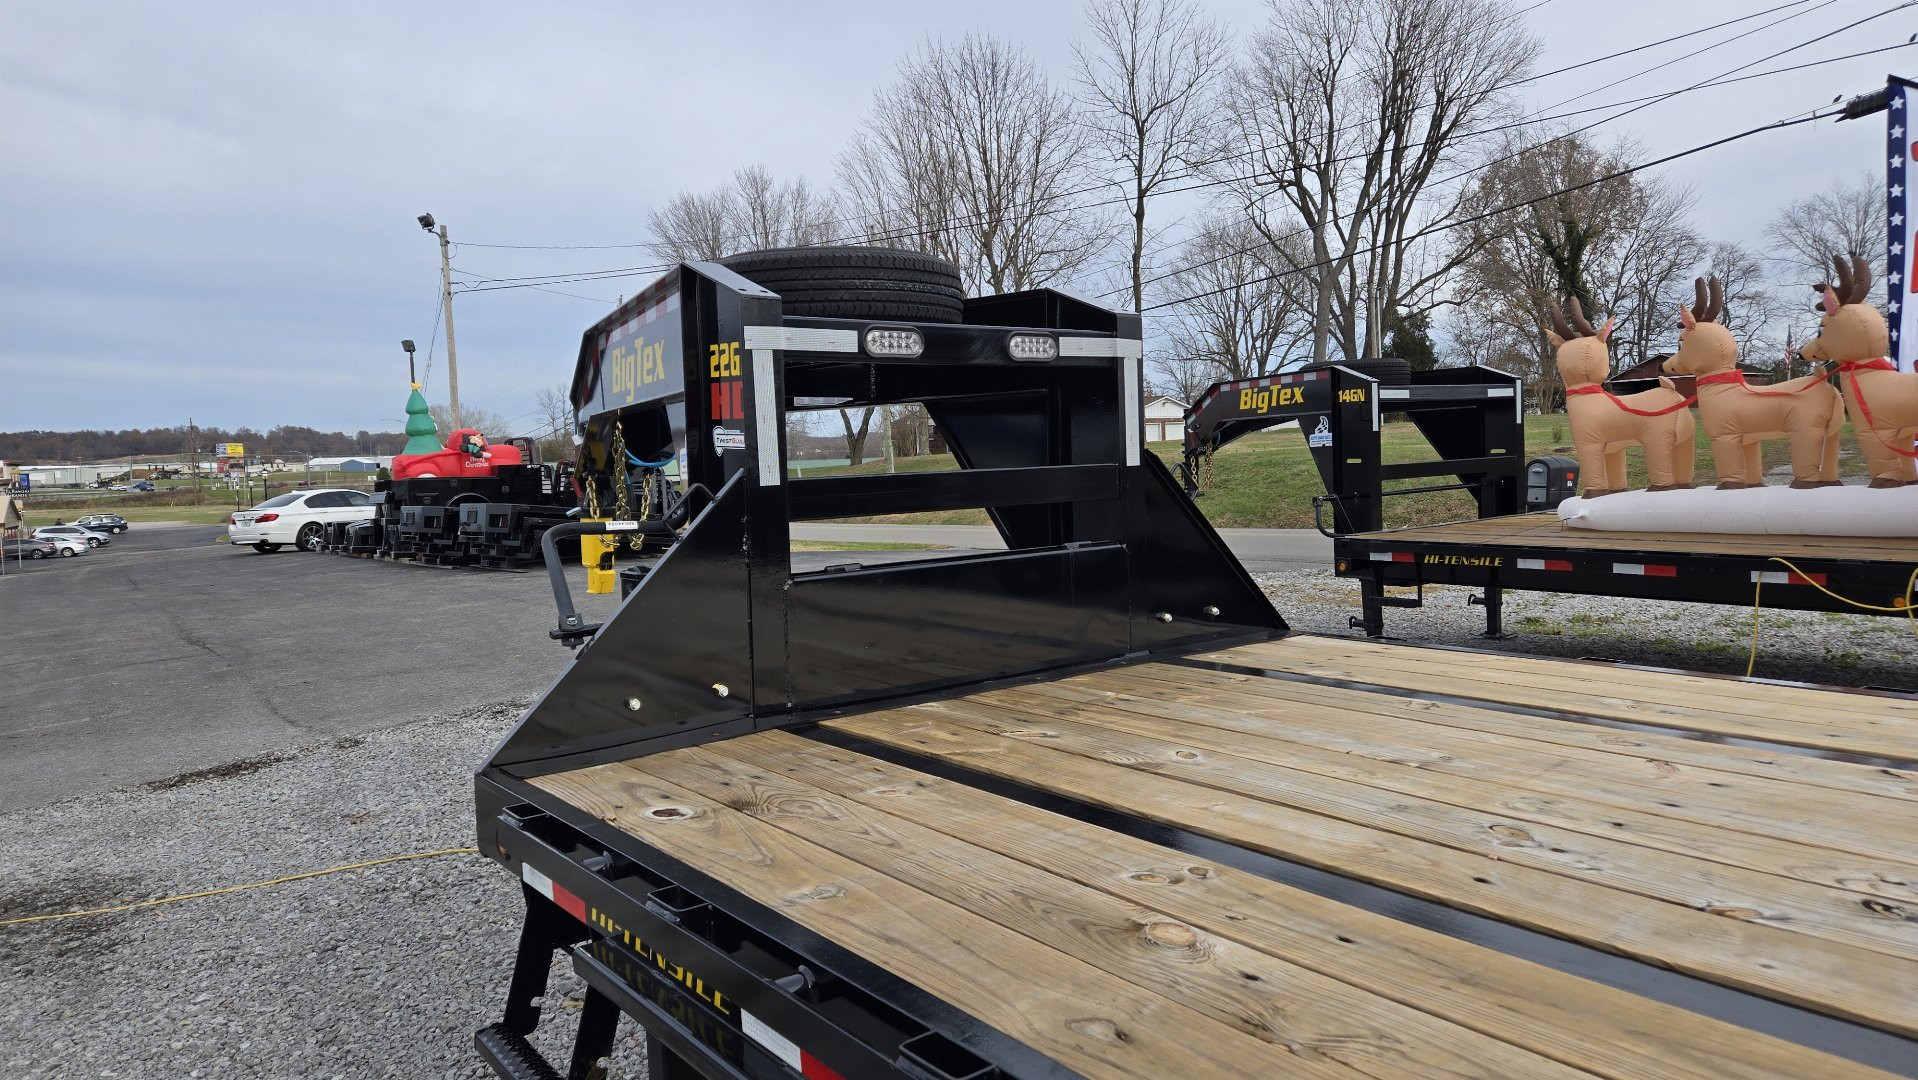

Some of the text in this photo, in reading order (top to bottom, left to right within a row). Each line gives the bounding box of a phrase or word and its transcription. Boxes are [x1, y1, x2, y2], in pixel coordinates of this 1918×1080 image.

[612, 336, 665, 404] BigTex
[1239, 384, 1305, 414] BigTex
[1424, 554, 1504, 567] HI-TENSILE
